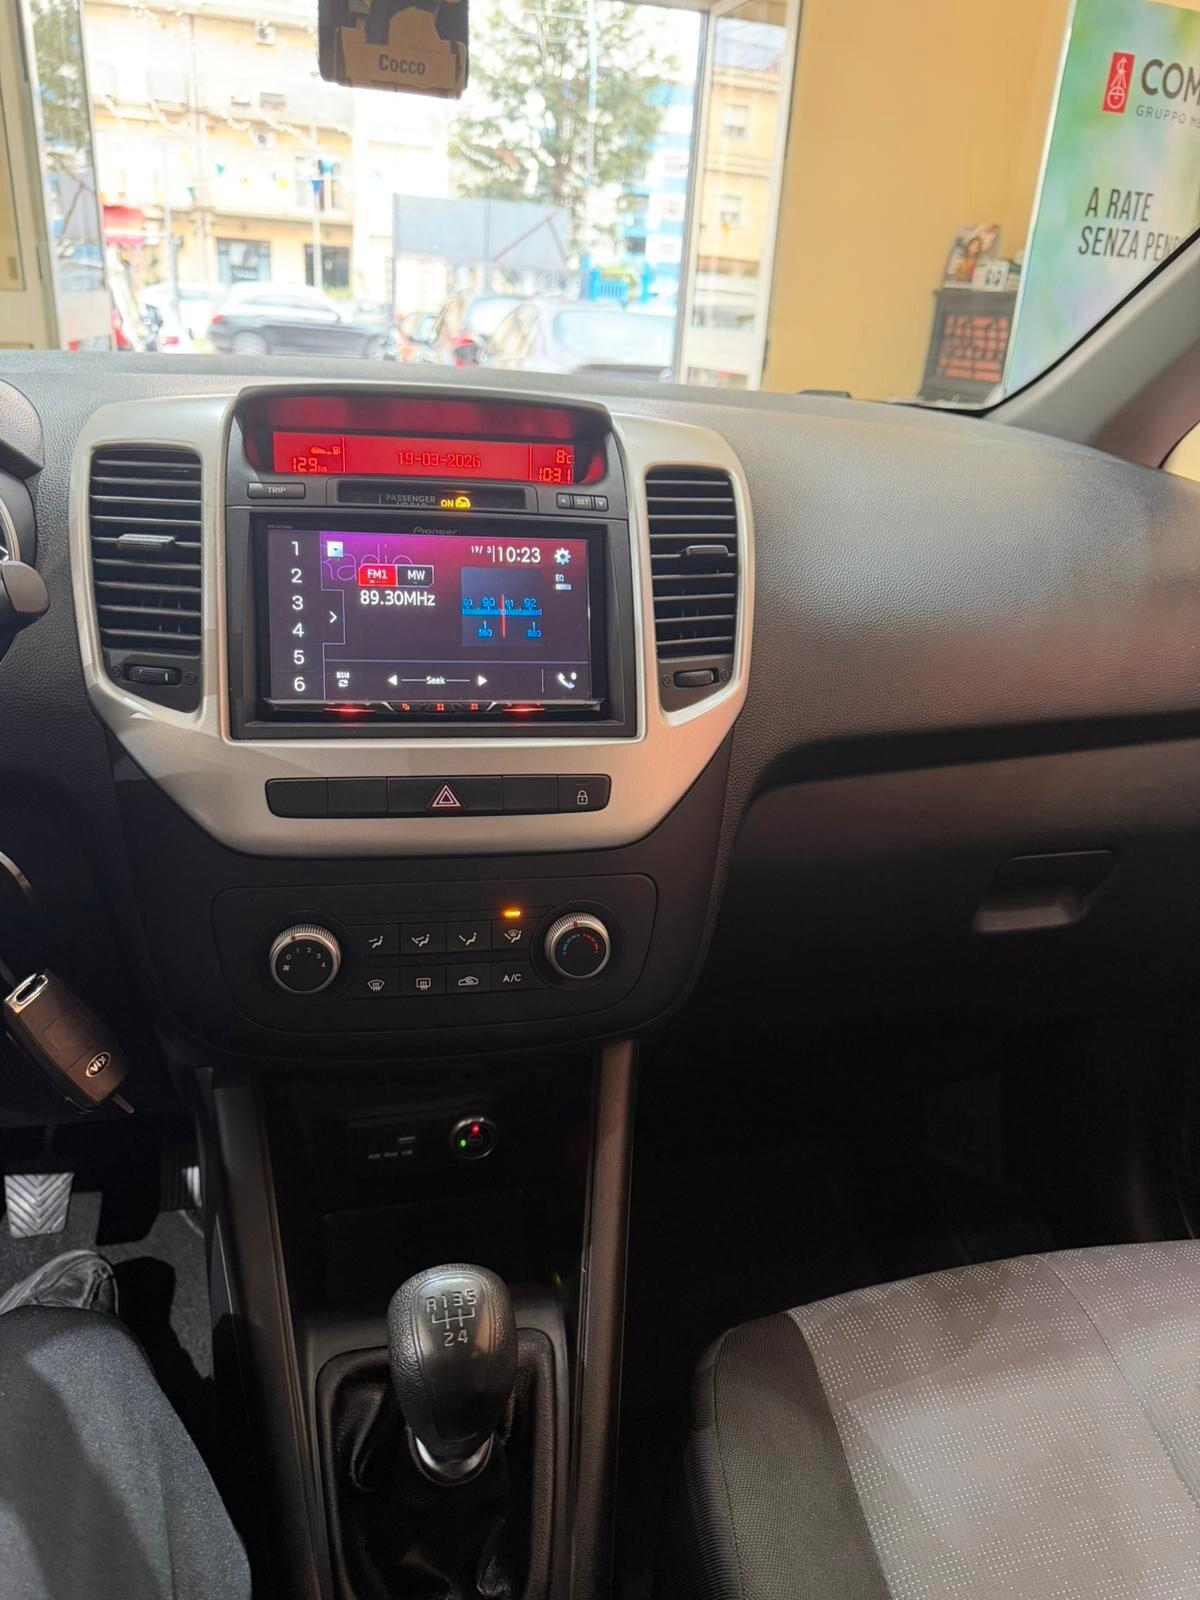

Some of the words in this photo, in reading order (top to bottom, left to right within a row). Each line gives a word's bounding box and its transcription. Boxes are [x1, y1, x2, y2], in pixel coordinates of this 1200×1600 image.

[379, 54, 426, 76] Cocco
[1136, 104, 1186, 124] GRUPPO
[1085, 186, 1100, 218] A
[1106, 188, 1154, 222] RATE
[1078, 225, 1139, 259] SENZA
[399, 451, 481, 468] 19-03-2026
[267, 486, 287, 494] TRIP
[385, 494, 436, 504] PASSENGER
[440, 499, 454, 508] ON
[413, 526, 458, 536] Pioneer
[291, 541, 299, 556] 1
[498, 546, 541, 563] 10:23
[291, 568, 303, 583] 2
[367, 568, 388, 579] FM1
[407, 569, 426, 580] MW
[292, 595, 304, 611] 3
[360, 590, 436, 606] 89.30MHz
[482, 597, 496, 607] 90
[292, 622, 304, 637] 4
[293, 649, 305, 665] 5
[294, 676, 306, 692] 6
[426, 675, 446, 685] Seek
[502, 973, 522, 983] A/C
[441, 1294, 448, 1309] 1
[452, 1291, 464, 1307] 3
[464, 1289, 477, 1305] 5
[443, 1332, 455, 1347] 2
[457, 1328, 469, 1344] 4
